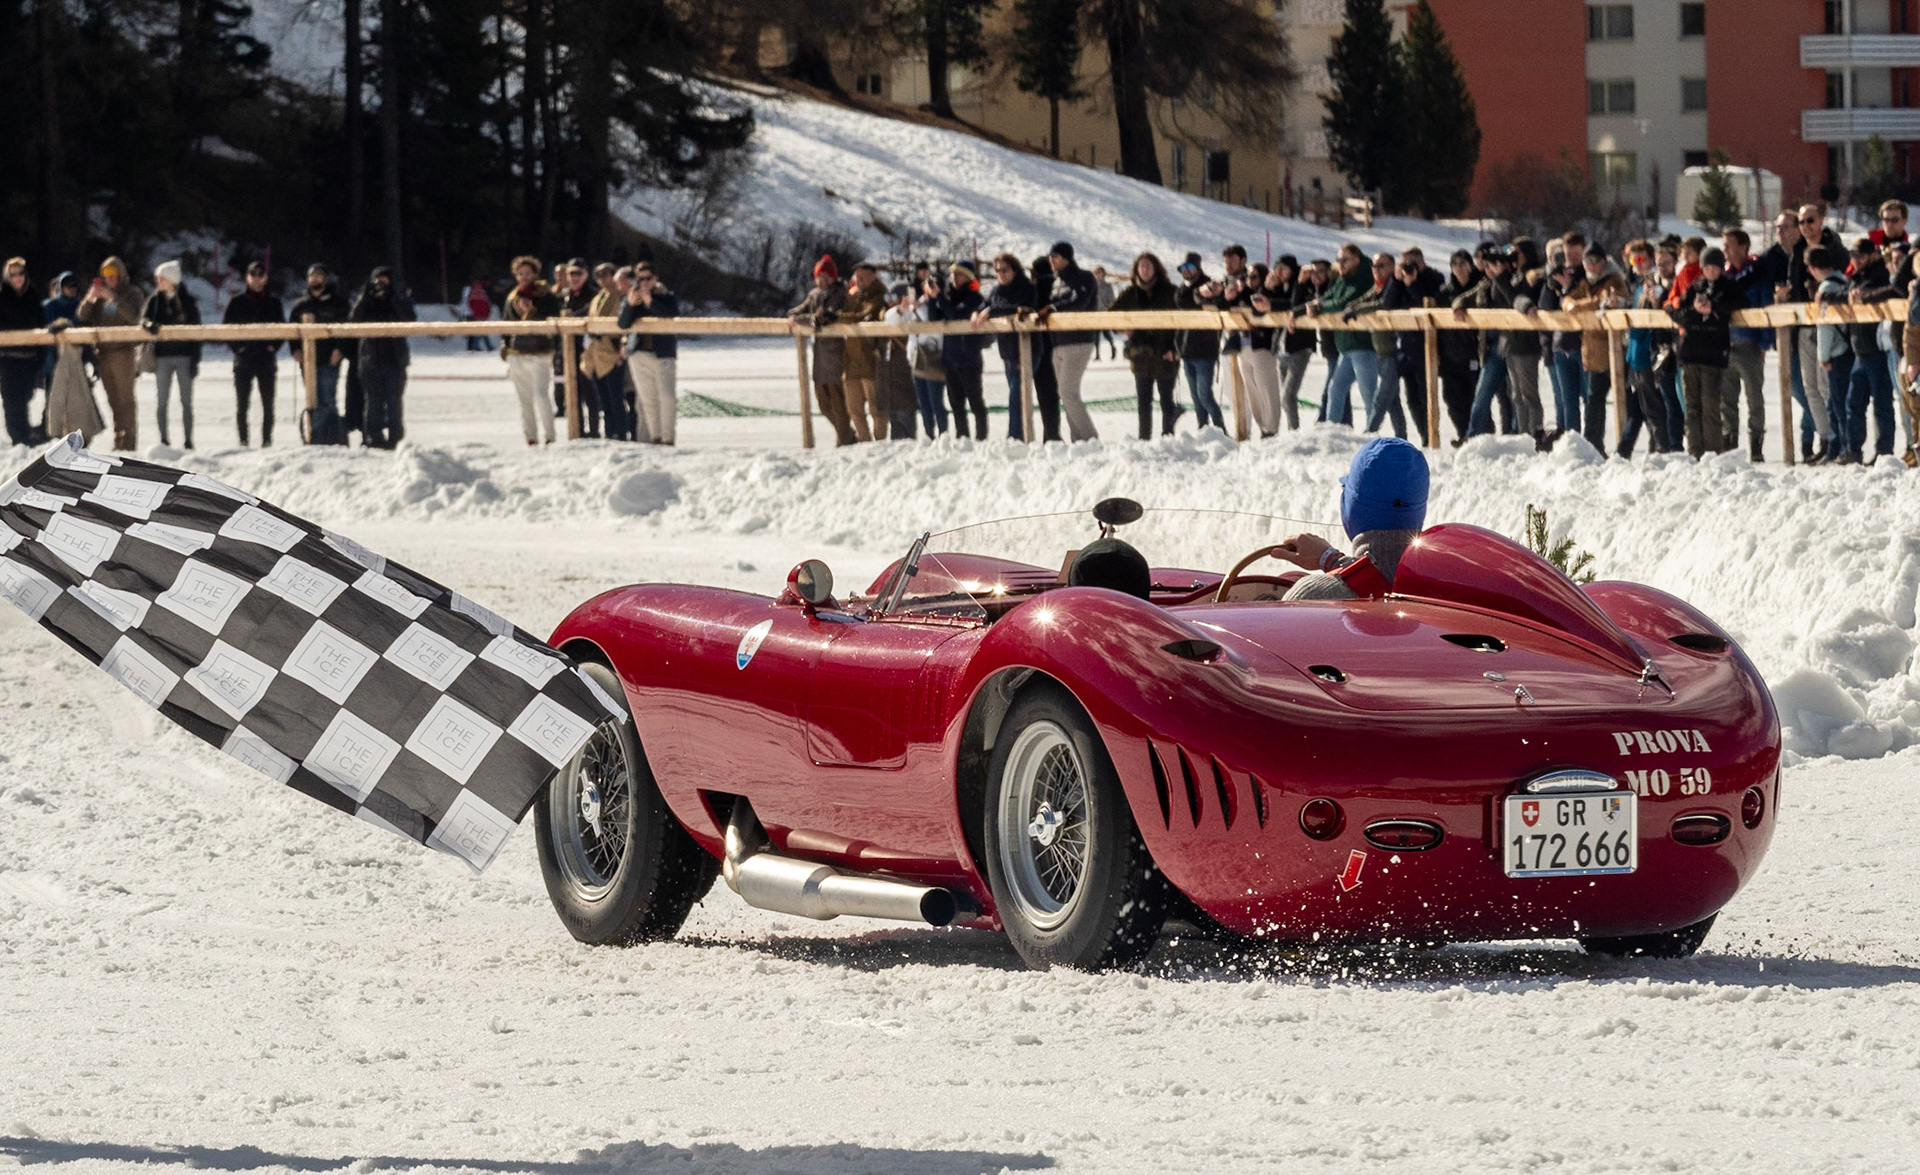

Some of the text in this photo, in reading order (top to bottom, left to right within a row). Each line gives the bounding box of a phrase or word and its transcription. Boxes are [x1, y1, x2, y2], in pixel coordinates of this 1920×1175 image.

[114, 486, 147, 499] THE
[249, 522, 279, 538] ICE
[254, 517, 285, 532] THE
[62, 533, 94, 554] THE
[3, 574, 33, 601] THE
[195, 579, 225, 600] THE
[287, 578, 317, 598] ICE
[293, 571, 324, 589] THE
[186, 594, 217, 609] ICE
[380, 583, 412, 602] ICE
[319, 642, 352, 668] THE
[411, 649, 442, 672] ICE
[416, 640, 449, 664] THE
[122, 664, 151, 690] THE
[219, 668, 250, 690] THE
[313, 655, 344, 679] ICE
[214, 677, 242, 699] ICE
[444, 718, 475, 744] THE
[535, 724, 566, 750] ICE
[540, 713, 573, 738] THE
[340, 735, 373, 764] THE
[435, 731, 467, 757] ICE
[1611, 728, 1713, 756] PROVA
[331, 751, 363, 778] ICE
[1624, 767, 1712, 797] MO 59
[1556, 800, 1586, 827] GR
[462, 816, 493, 845] THE
[455, 833, 483, 857] ICE
[1512, 830, 1630, 870] 172 666
